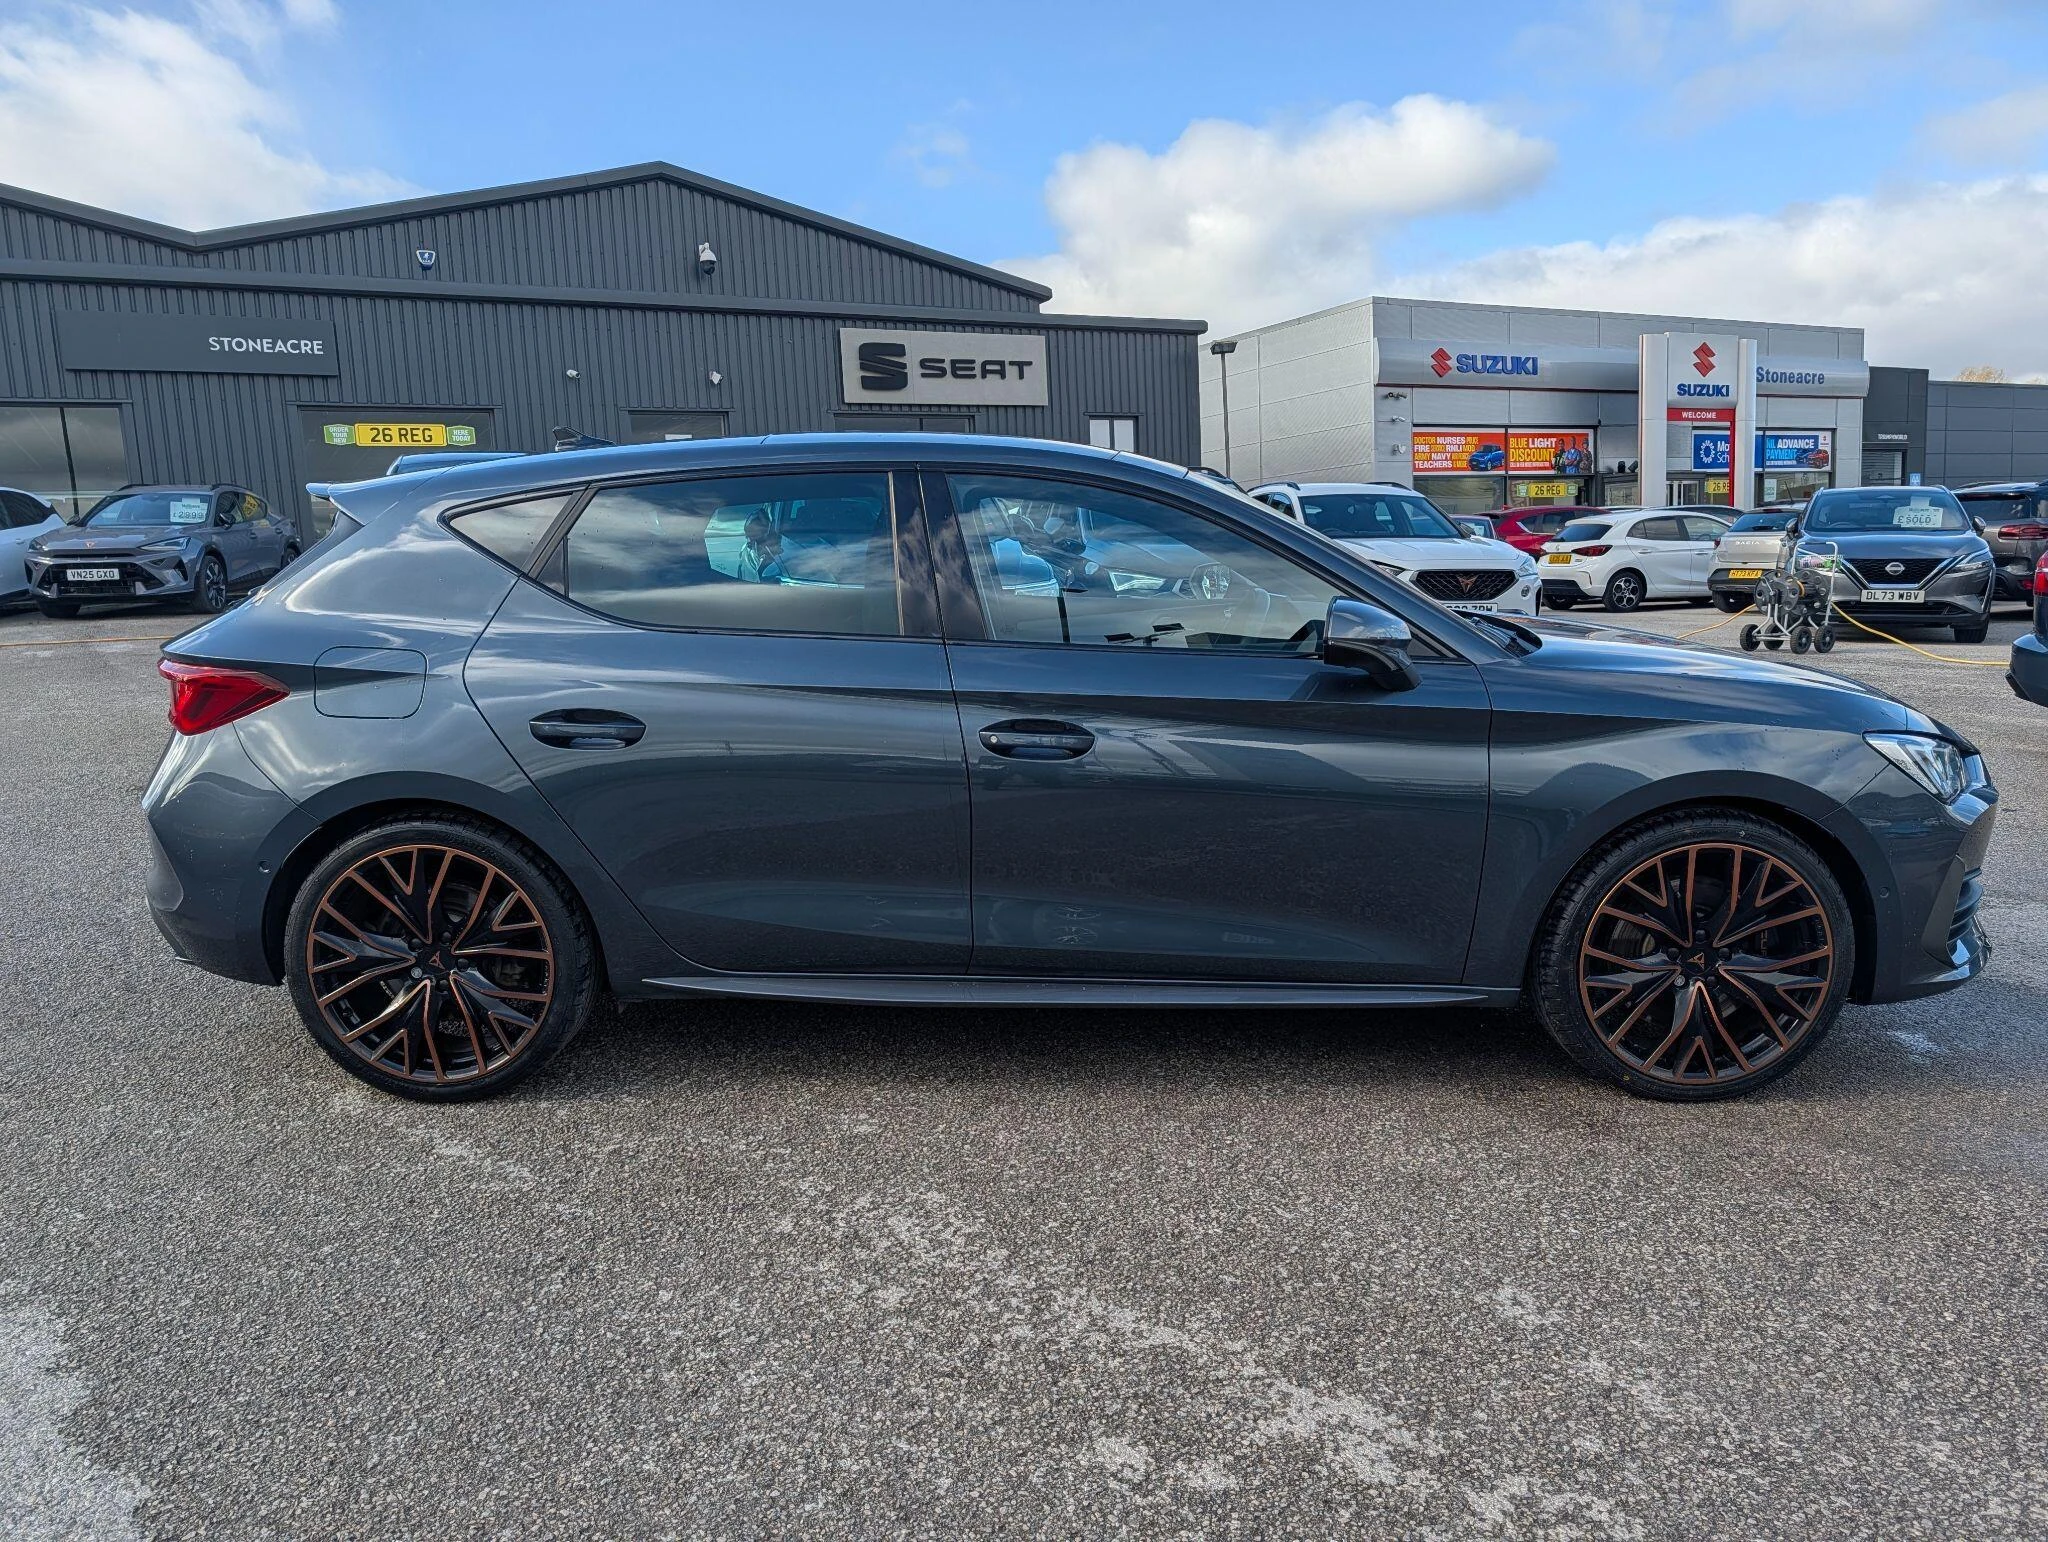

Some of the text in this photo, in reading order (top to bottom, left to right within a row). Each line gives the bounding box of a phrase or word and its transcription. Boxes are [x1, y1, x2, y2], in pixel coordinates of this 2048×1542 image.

[208, 336, 324, 355] STONEACRE
[919, 357, 1033, 380] SEAT
[1456, 353, 1539, 376] SUZUKI
[1756, 366, 1825, 385] Stoneacre
[1676, 383, 1730, 398] SUZUKI
[1681, 411, 1717, 420] WELCOME
[370, 427, 433, 443] 26 REG
[1509, 438, 1557, 448] BLUE LIGHT
[1777, 439, 1814, 448] ADVANCE
[1509, 449, 1555, 461] DISCOUNT
[1766, 449, 1797, 460] PAYMENT
[1535, 486, 1544, 496] 26
[1546, 486, 1560, 496] REG
[1906, 516, 1932, 524] SOLD
[70, 570, 94, 578] VN25
[1866, 592, 1920, 600] DL73 WBV
